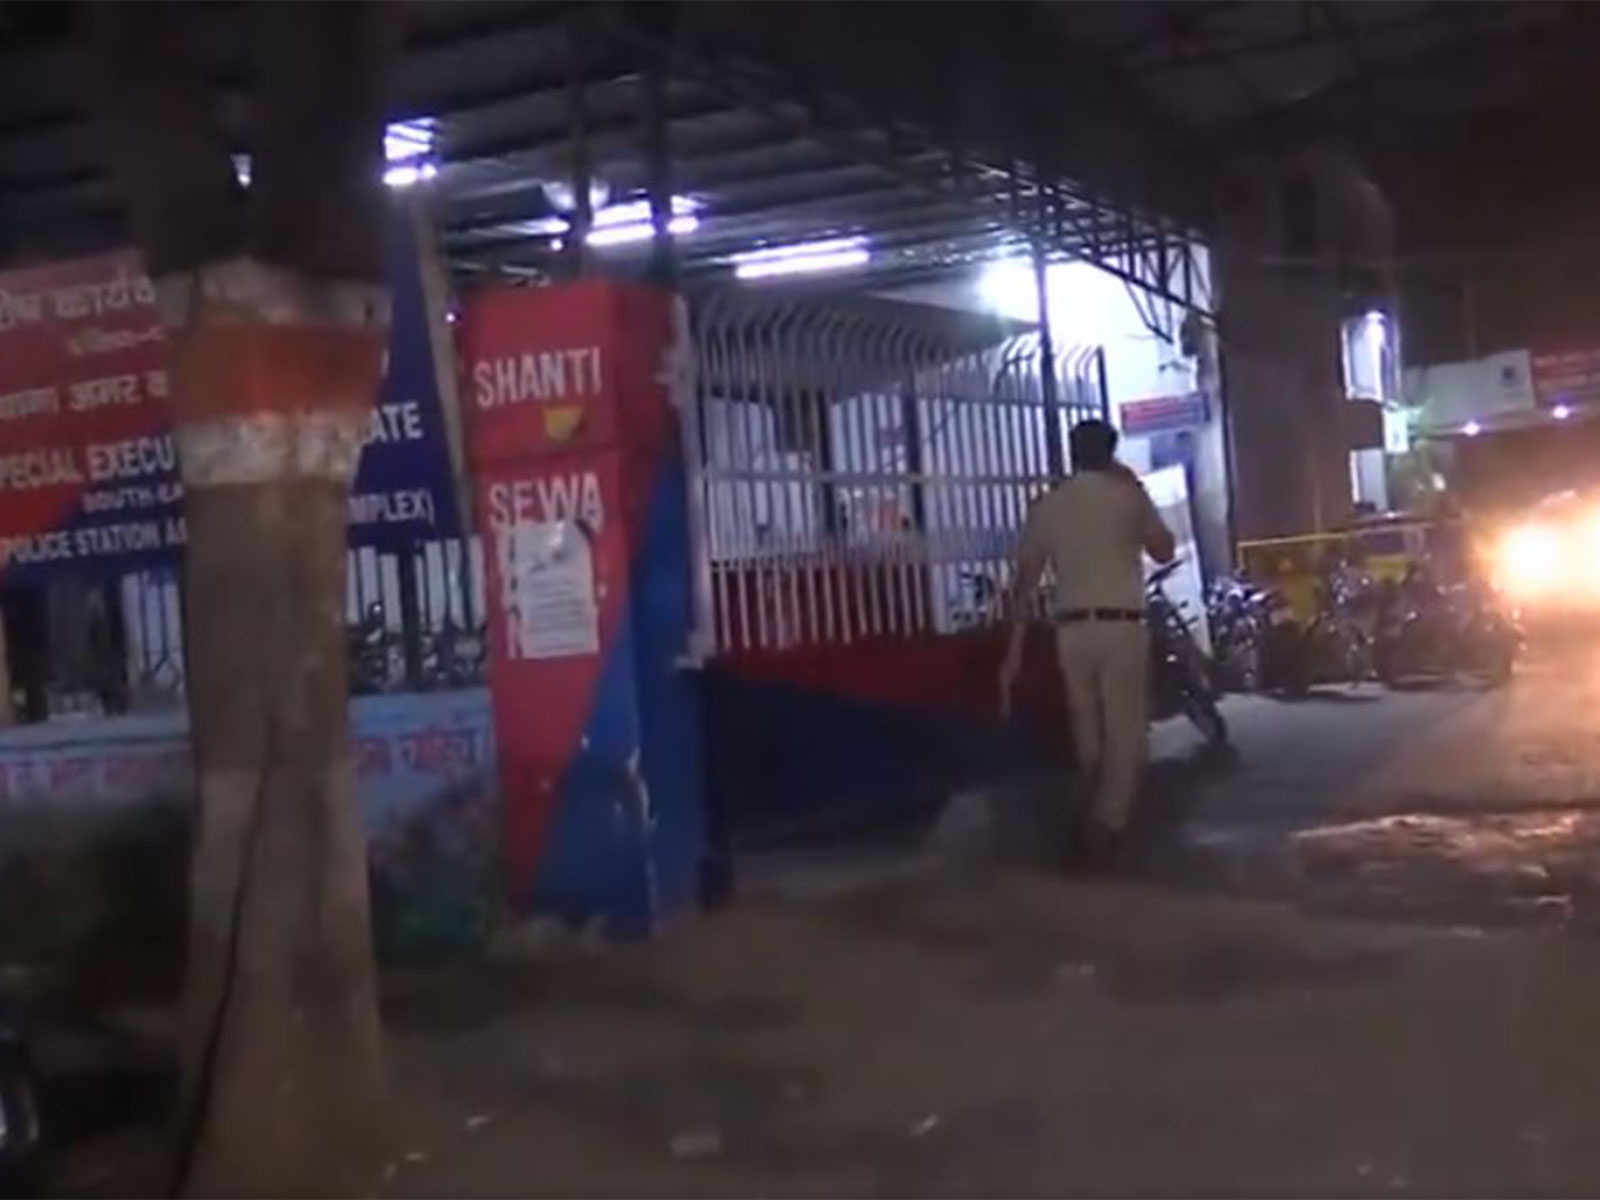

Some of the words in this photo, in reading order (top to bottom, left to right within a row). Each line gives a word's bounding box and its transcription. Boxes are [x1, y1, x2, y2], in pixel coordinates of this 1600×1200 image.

[473, 346, 603, 409] SHANTI
[86, 434, 175, 482] EXECU
[488, 471, 605, 535] SEWA
[75, 522, 160, 556] STATION
